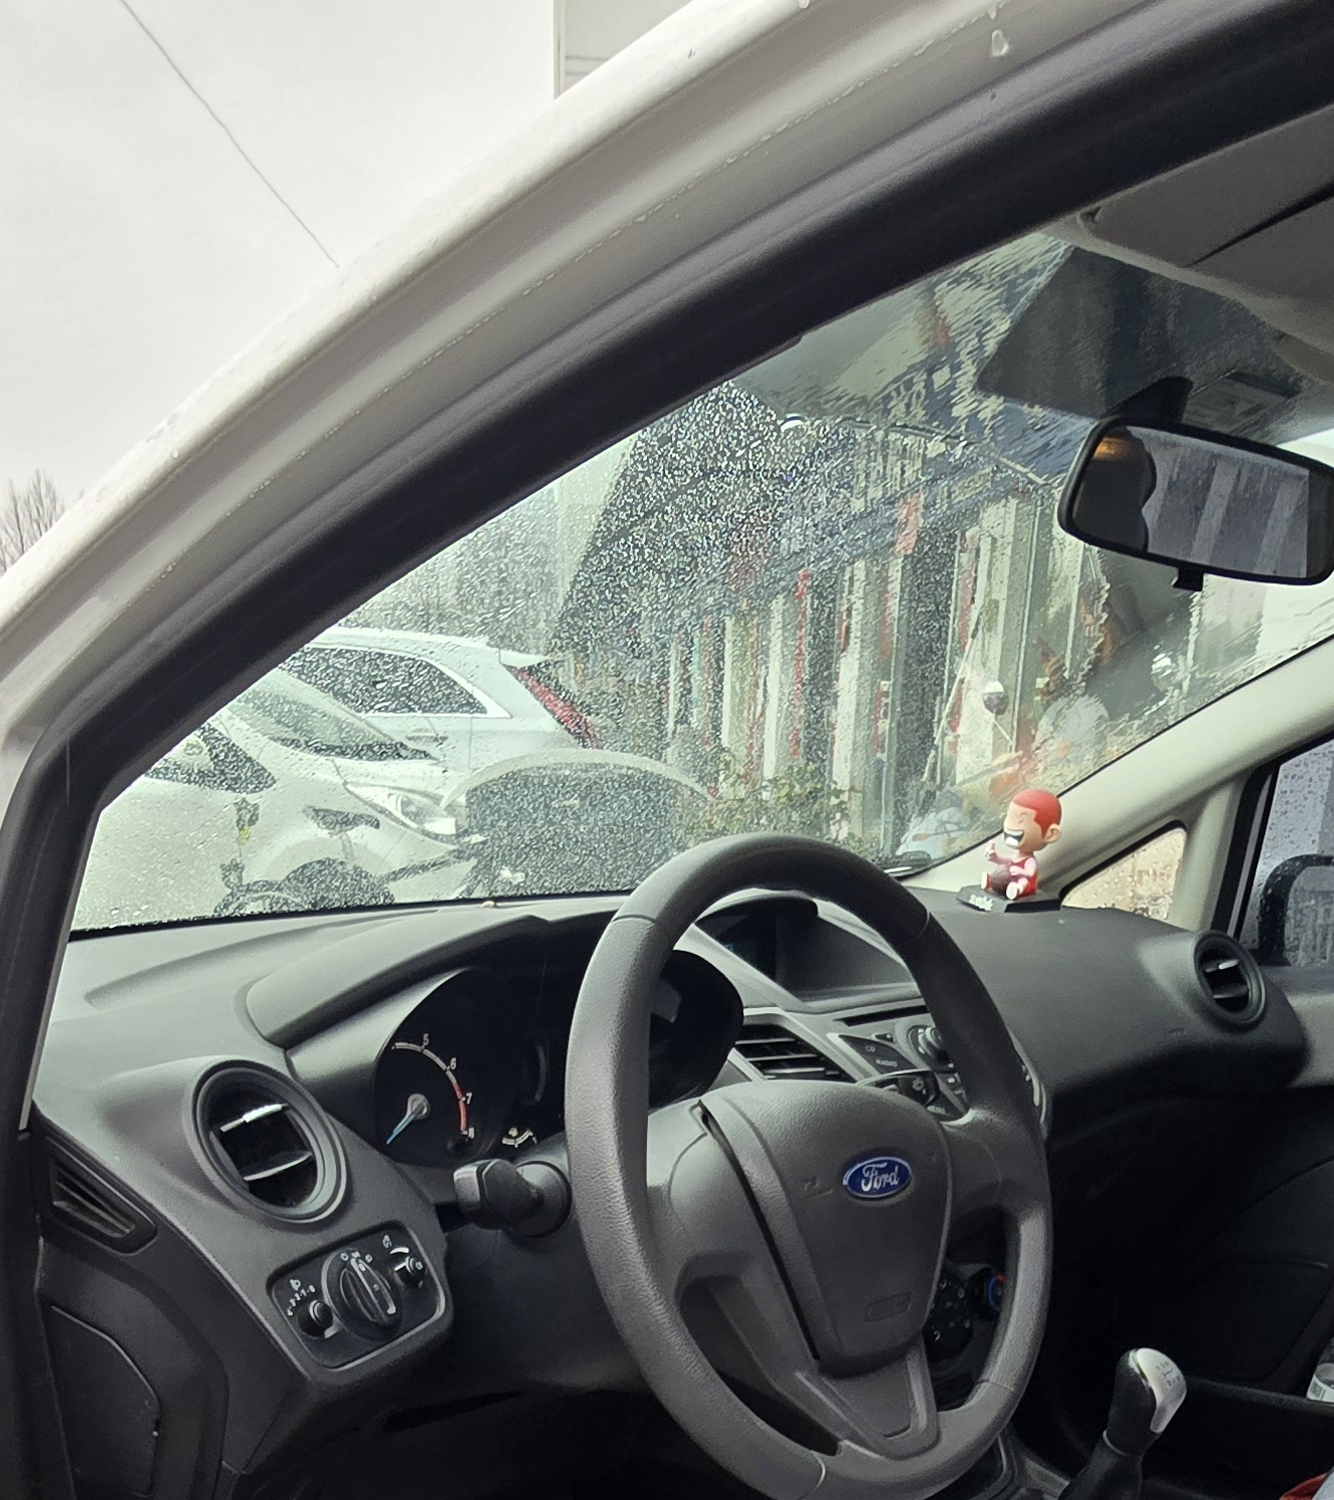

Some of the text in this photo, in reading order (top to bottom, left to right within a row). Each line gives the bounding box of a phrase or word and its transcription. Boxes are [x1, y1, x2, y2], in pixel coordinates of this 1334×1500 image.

[422, 1033, 430, 1046] 5
[449, 1057, 457, 1070] 6
[466, 1092, 473, 1105] 7
[861, 1162, 900, 1192] Ford
